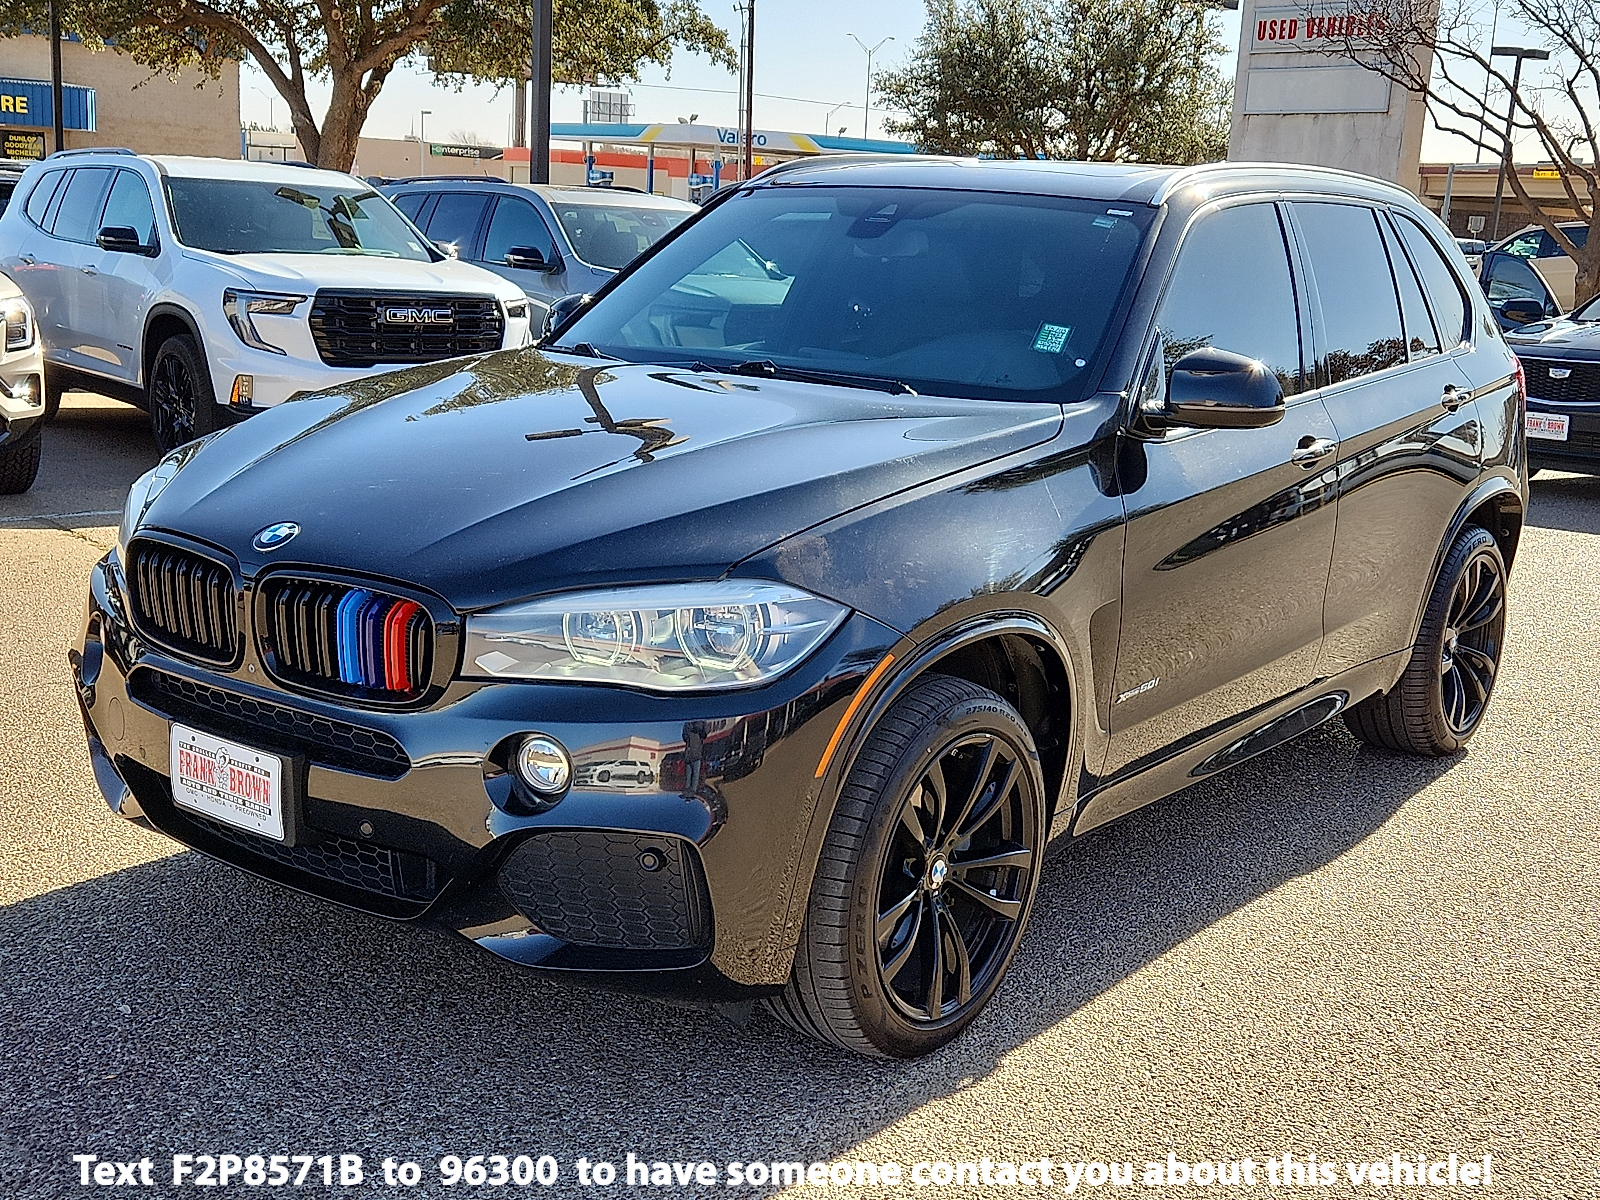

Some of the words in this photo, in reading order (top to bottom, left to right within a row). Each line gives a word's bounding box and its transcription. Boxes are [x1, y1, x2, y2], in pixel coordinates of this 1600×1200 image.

[1257, 19, 1298, 41] USED
[0, 95, 28, 114] RE
[4, 141, 43, 151] GOODYEAR
[8, 134, 37, 143] DUNLOP
[6, 148, 40, 157] MICHELIN
[433, 145, 480, 156] enterprise
[386, 308, 454, 324] GMC
[965, 704, 998, 715] 275/40
[178, 749, 216, 787] FRANK
[229, 767, 271, 807] BROWN
[182, 778, 201, 790] AUTO
[202, 785, 218, 796] AND
[218, 791, 244, 805] TRUCK
[244, 800, 270, 816] RANCH
[185, 787, 198, 797] GMC
[206, 794, 227, 807] HONDA
[234, 804, 267, 822] PREOWNED
